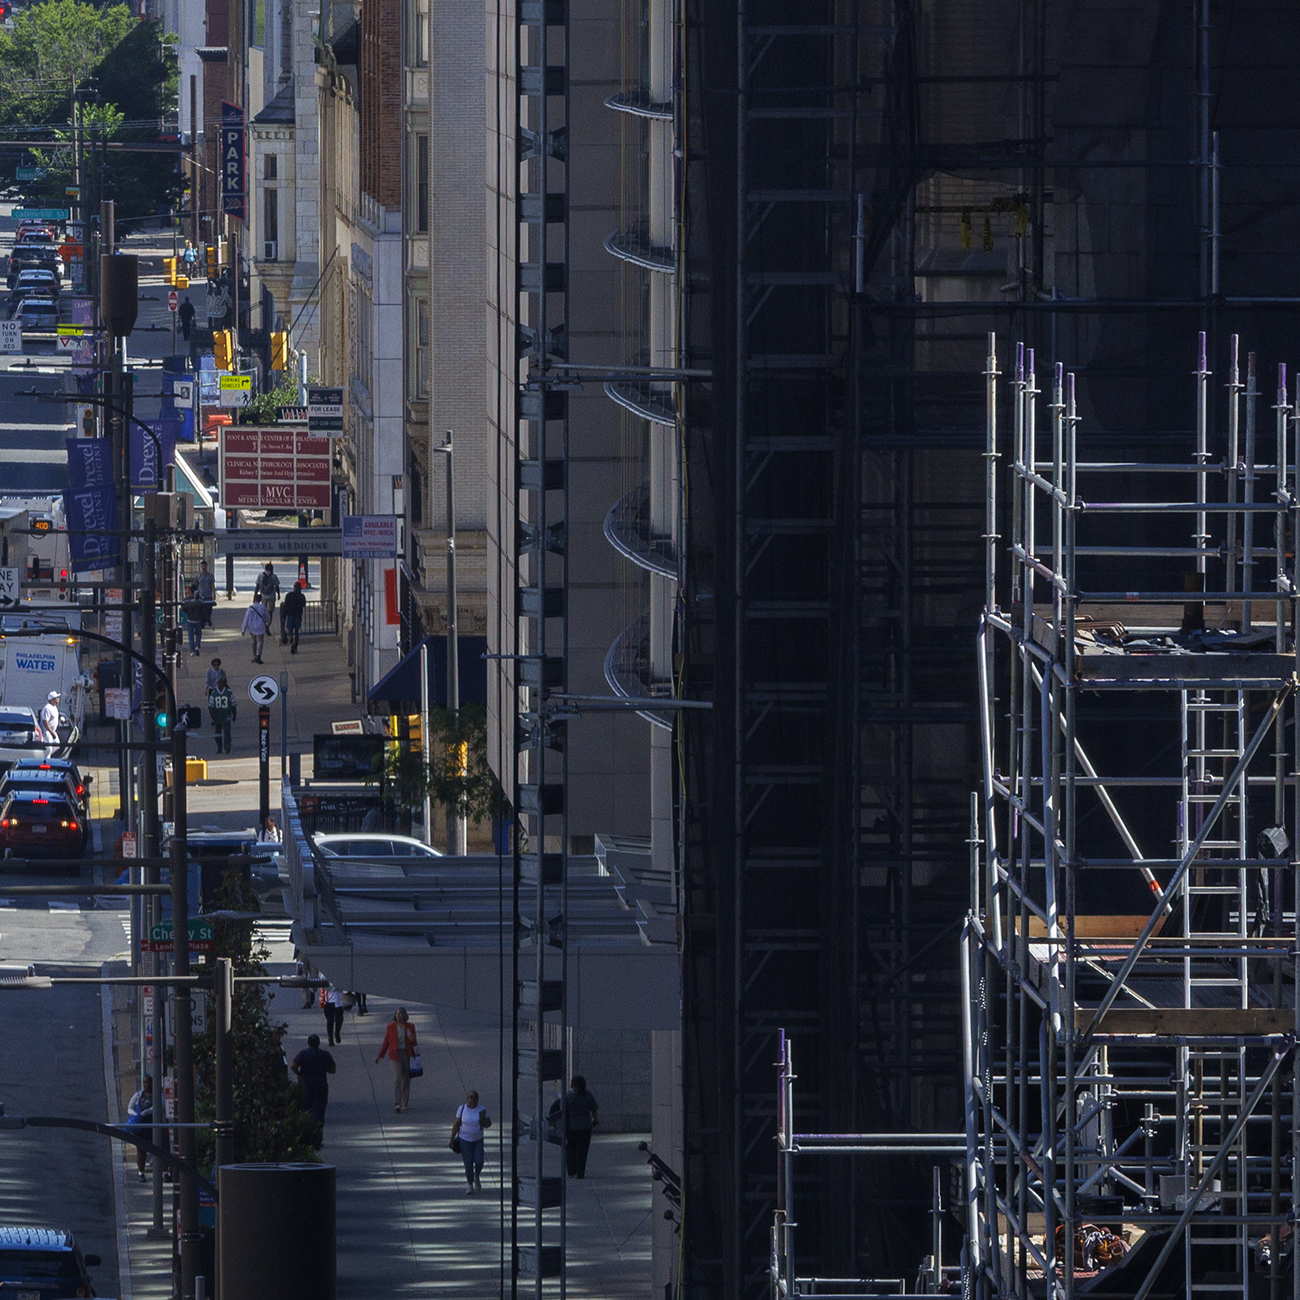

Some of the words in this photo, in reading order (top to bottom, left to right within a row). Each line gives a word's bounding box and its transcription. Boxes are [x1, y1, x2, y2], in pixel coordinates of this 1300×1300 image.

[227, 132, 239, 190] PARK
[1, 323, 16, 331] NO
[266, 487, 291, 497] MVC
[364, 521, 394, 529] AVAILABLE
[234, 542, 274, 551] DREXEL
[278, 542, 328, 550] MEDICINE
[15, 652, 56, 661] PHILADELPHIA
[15, 660, 56, 671] WATER
[214, 696, 228, 709] 83
[260, 729, 268, 762] Race-Vine
[200, 928, 212, 939] St
